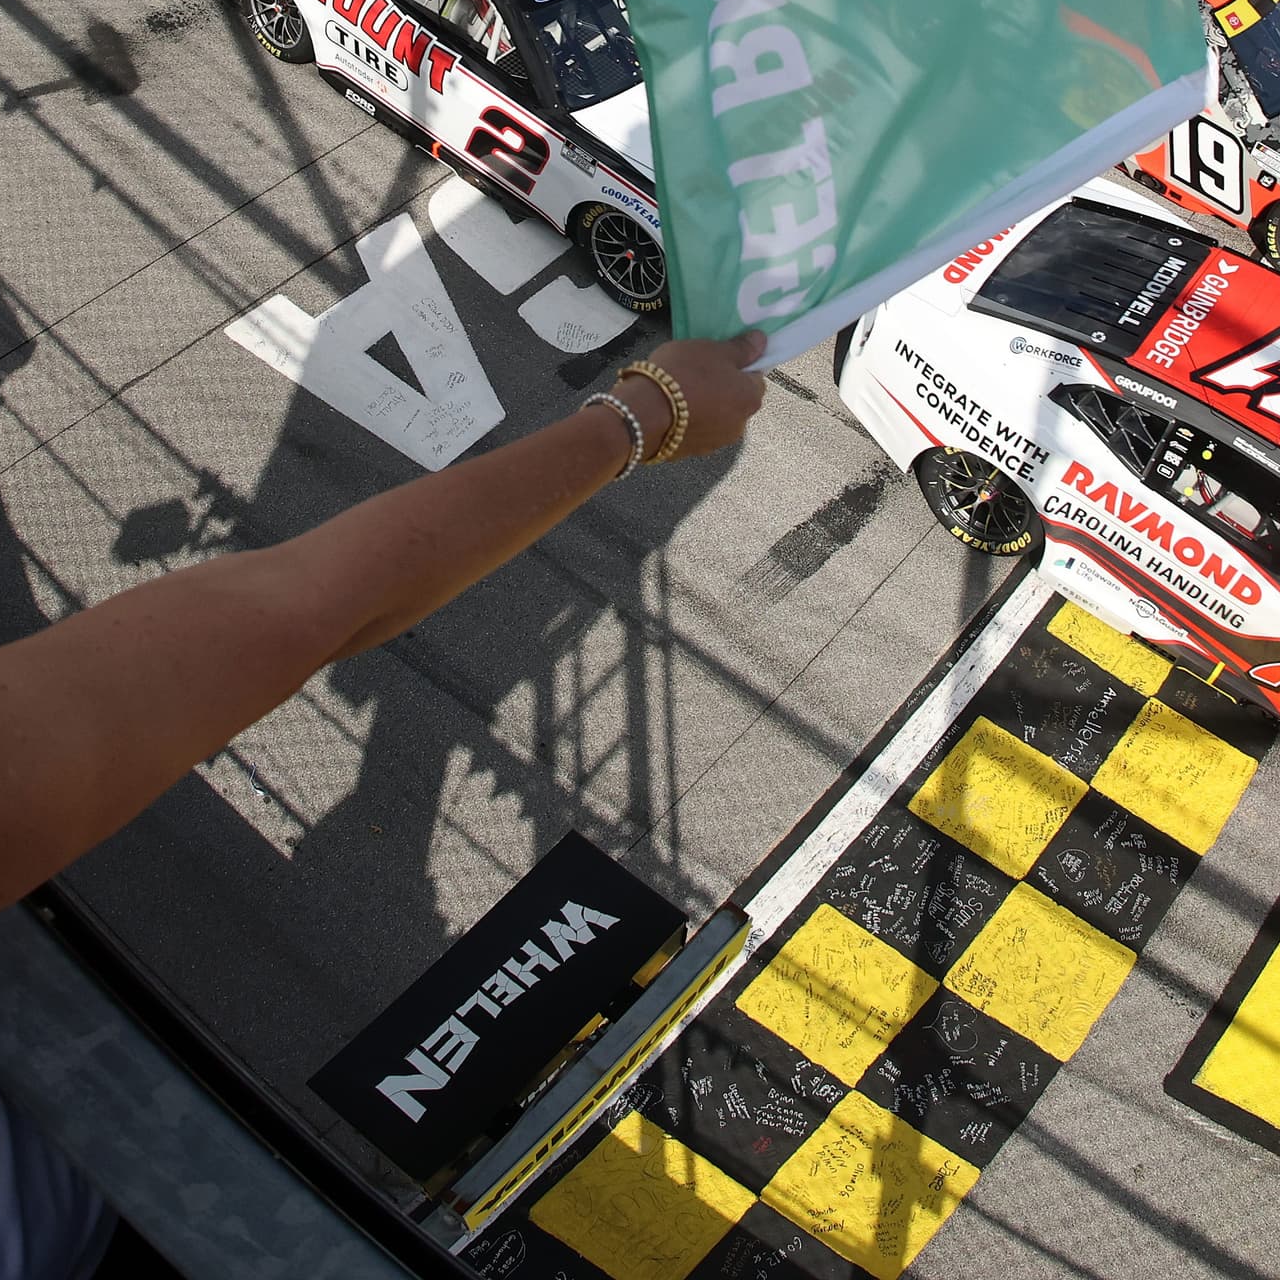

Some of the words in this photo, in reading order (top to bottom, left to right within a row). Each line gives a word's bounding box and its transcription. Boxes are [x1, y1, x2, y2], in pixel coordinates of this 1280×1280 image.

[333, 27, 401, 85] TIRE
[334, 51, 376, 86] Autotrader
[344, 88, 377, 114] FORD
[463, 104, 552, 199] 2
[1168, 119, 1246, 217] 19
[600, 184, 662, 230] GOODYEAR
[1270, 219, 1280, 260] EAGLE
[631, 297, 664, 313] EAGLE
[1118, 255, 1188, 328] MCDOWELL
[1146, 273, 1230, 369] GAINBRIDGE
[1010, 336, 1084, 369] WORKFORCE
[894, 339, 993, 428] INTEGRATE
[994, 422, 1051, 466] WITH
[1114, 374, 1178, 411] GROUP1001
[915, 382, 1036, 484] CONFIDENCE.
[1043, 494, 1142, 561] CAROLINA
[1146, 556, 1247, 630] HANDLING
[1060, 460, 1263, 607] RAYMOND
[1076, 570, 1094, 583] Life
[1079, 560, 1122, 592] Delaware
[374, 899, 622, 1125] WHELEN
[475, 955, 729, 1219] YellaWood
